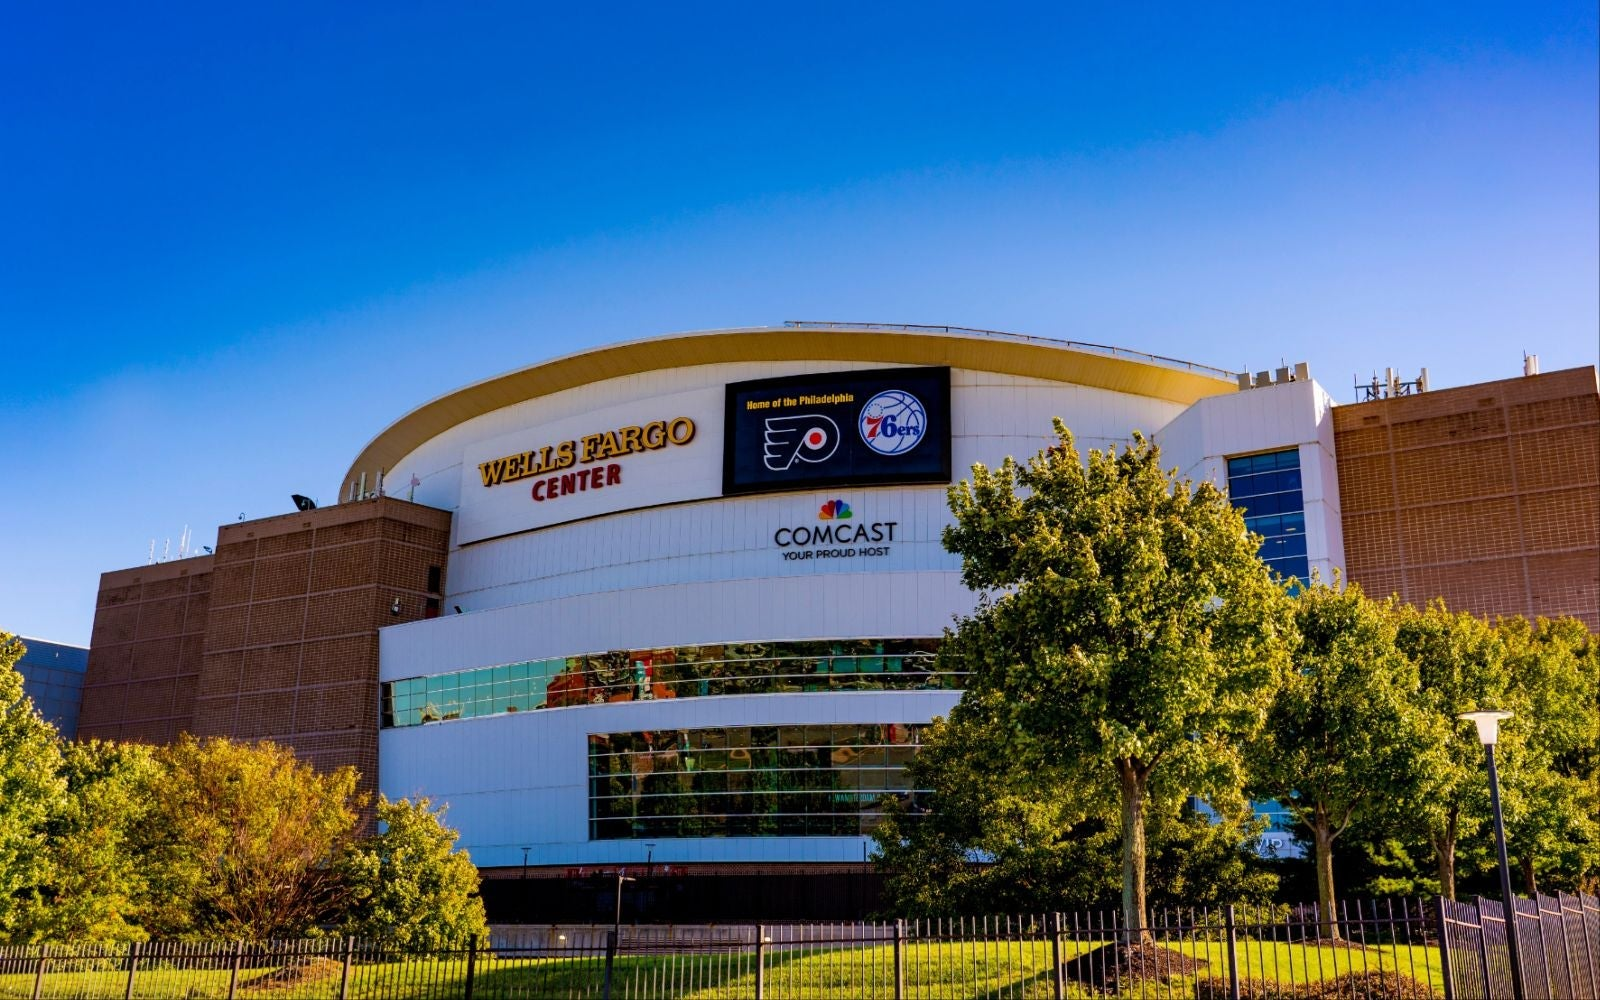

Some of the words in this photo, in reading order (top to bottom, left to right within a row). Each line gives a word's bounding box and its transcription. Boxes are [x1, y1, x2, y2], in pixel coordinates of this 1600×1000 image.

[746, 400, 770, 410] Home
[772, 398, 781, 408] of
[783, 397, 797, 406] the
[799, 393, 854, 405] Philadelphia
[866, 414, 920, 438] 76ers
[478, 440, 577, 487] WELLS
[580, 416, 696, 464] FARGO
[532, 464, 621, 501] CENTER
[774, 522, 897, 547] COMCAST
[782, 550, 813, 560] YOUR
[816, 548, 856, 558] PROUD
[859, 547, 890, 556] HOST
